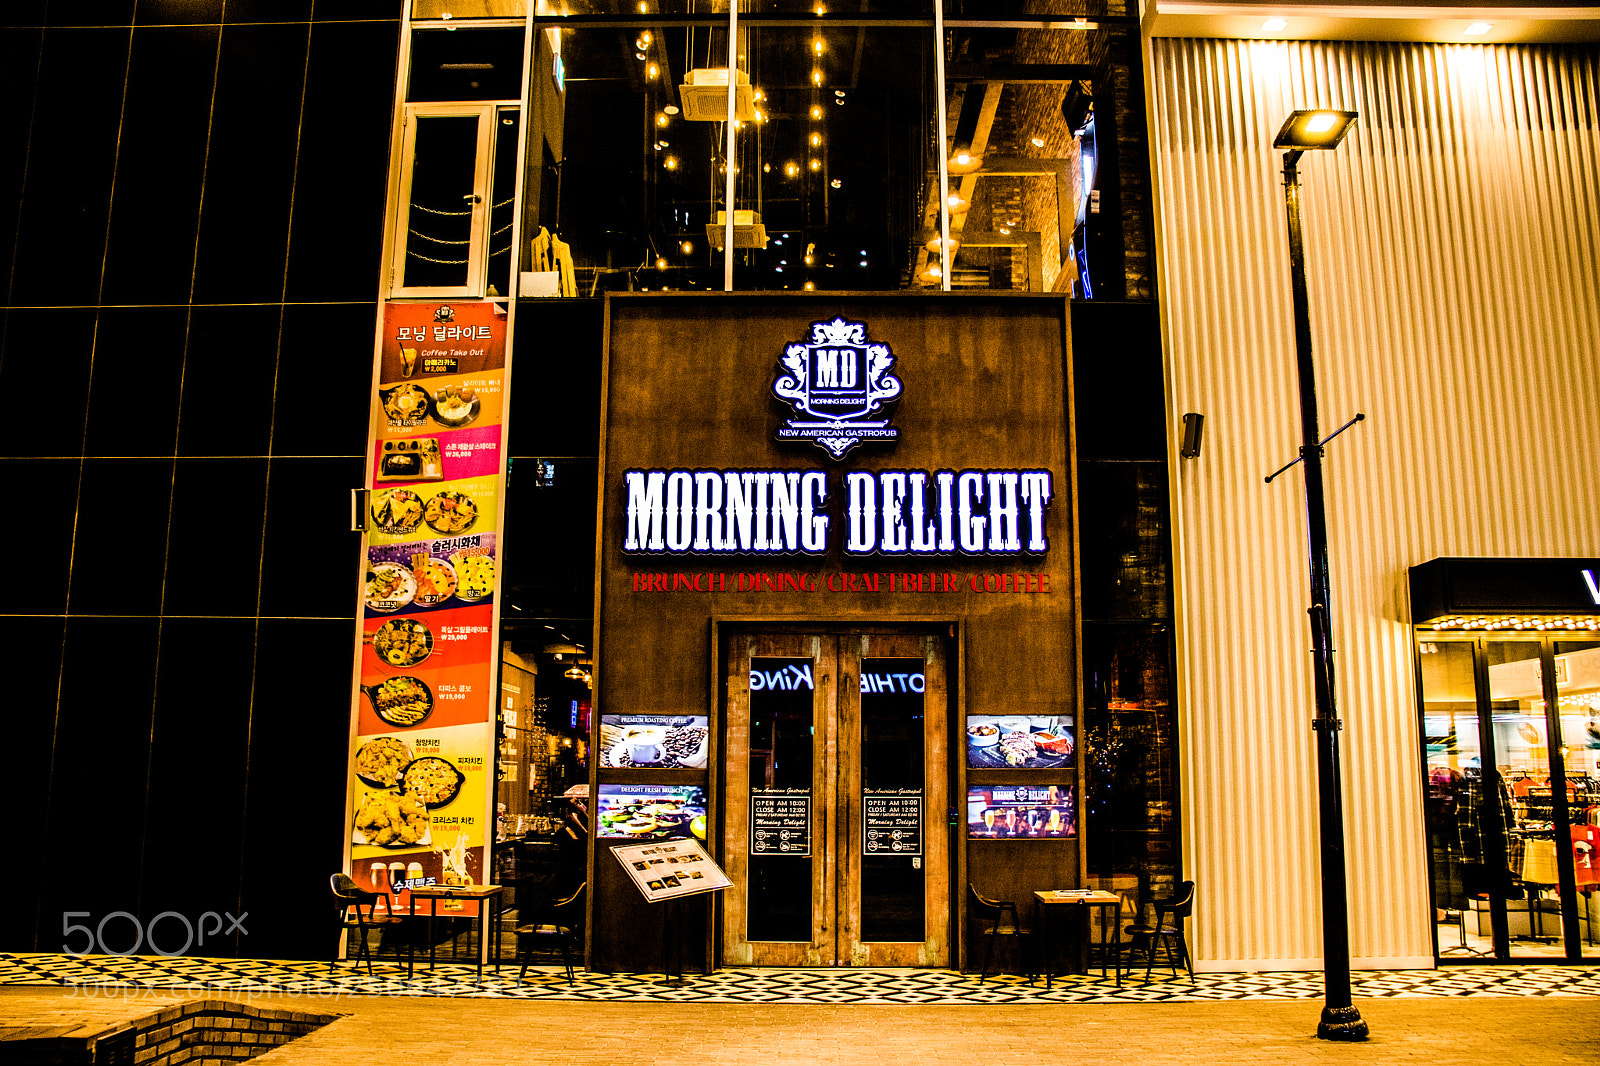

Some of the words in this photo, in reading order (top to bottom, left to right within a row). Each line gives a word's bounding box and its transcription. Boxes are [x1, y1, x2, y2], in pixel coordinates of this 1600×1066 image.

[396, 325, 426, 342] 모닝
[433, 325, 492, 341] 딜라이트
[421, 349, 448, 357] Coffee
[816, 349, 857, 388] MD
[779, 429, 800, 437] NEW
[800, 429, 844, 437] AMERICAN
[845, 429, 898, 437] GASTROPUB
[624, 471, 830, 552] MORNING
[845, 471, 1052, 552] DELIGHT
[431, 534, 482, 554] 슬러시화채
[460, 816, 475, 825] 치킨
[393, 876, 436, 892] 수제맥주
